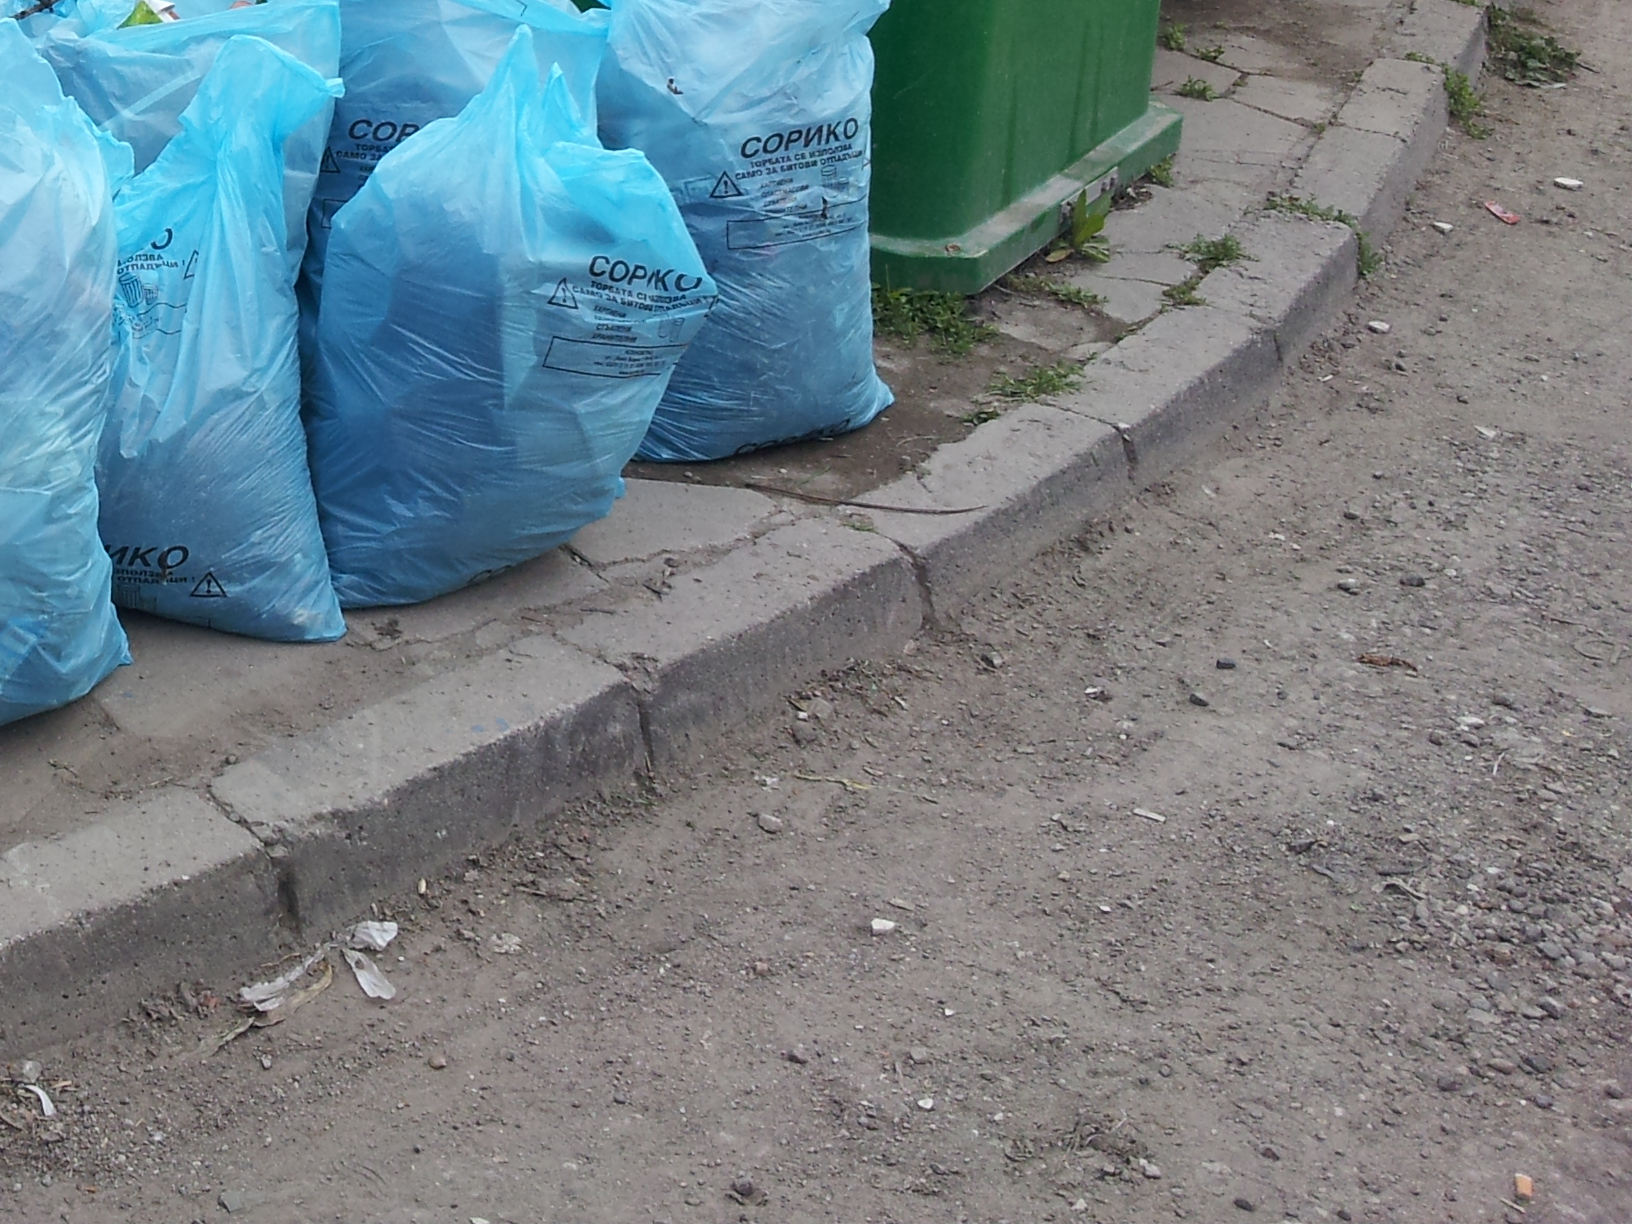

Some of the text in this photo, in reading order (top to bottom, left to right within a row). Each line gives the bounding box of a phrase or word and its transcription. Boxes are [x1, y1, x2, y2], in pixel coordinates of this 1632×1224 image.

[740, 117, 859, 159] СОРИКО
[750, 153, 792, 168] ТОРБАТА
[794, 152, 806, 161] СЕ
[735, 169, 763, 180] САМО
[765, 166, 778, 175] ЗА
[591, 280, 633, 297] ТОРБАТА
